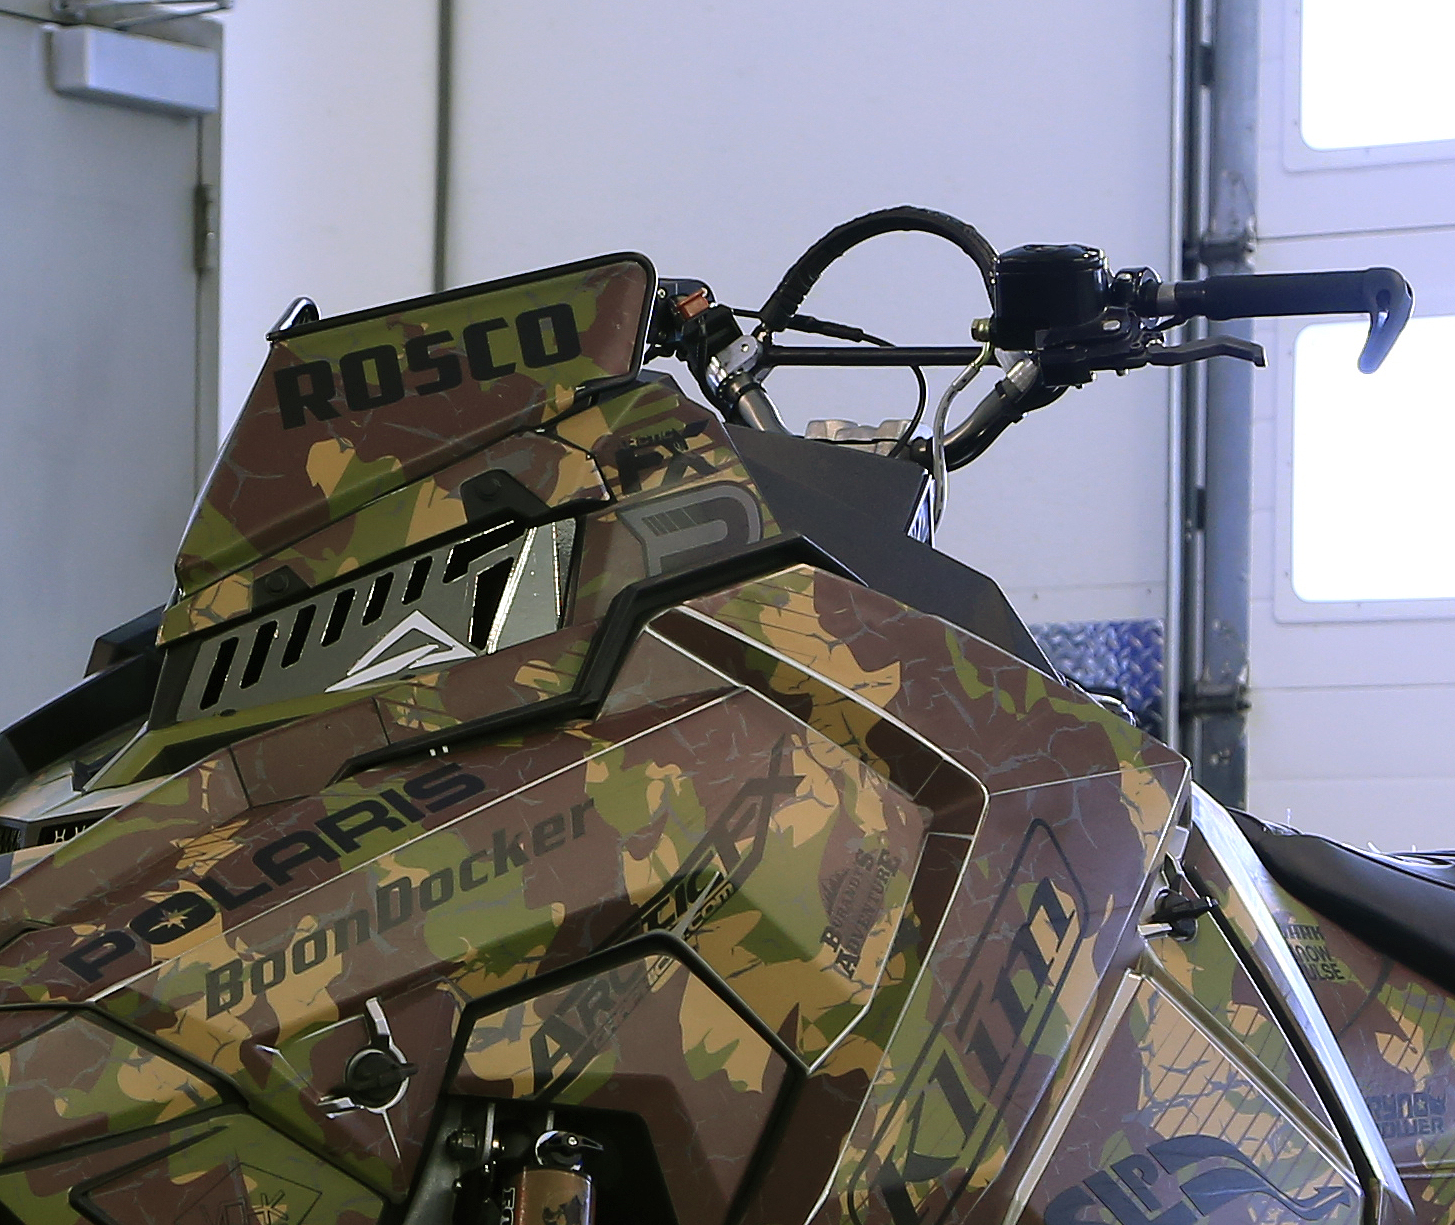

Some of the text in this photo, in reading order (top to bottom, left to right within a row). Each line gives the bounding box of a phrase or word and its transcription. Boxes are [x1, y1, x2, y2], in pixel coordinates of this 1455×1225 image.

[272, 303, 582, 430] ROSCO
[59, 761, 486, 983] POLARIS
[204, 799, 596, 1020] BoonDocker
